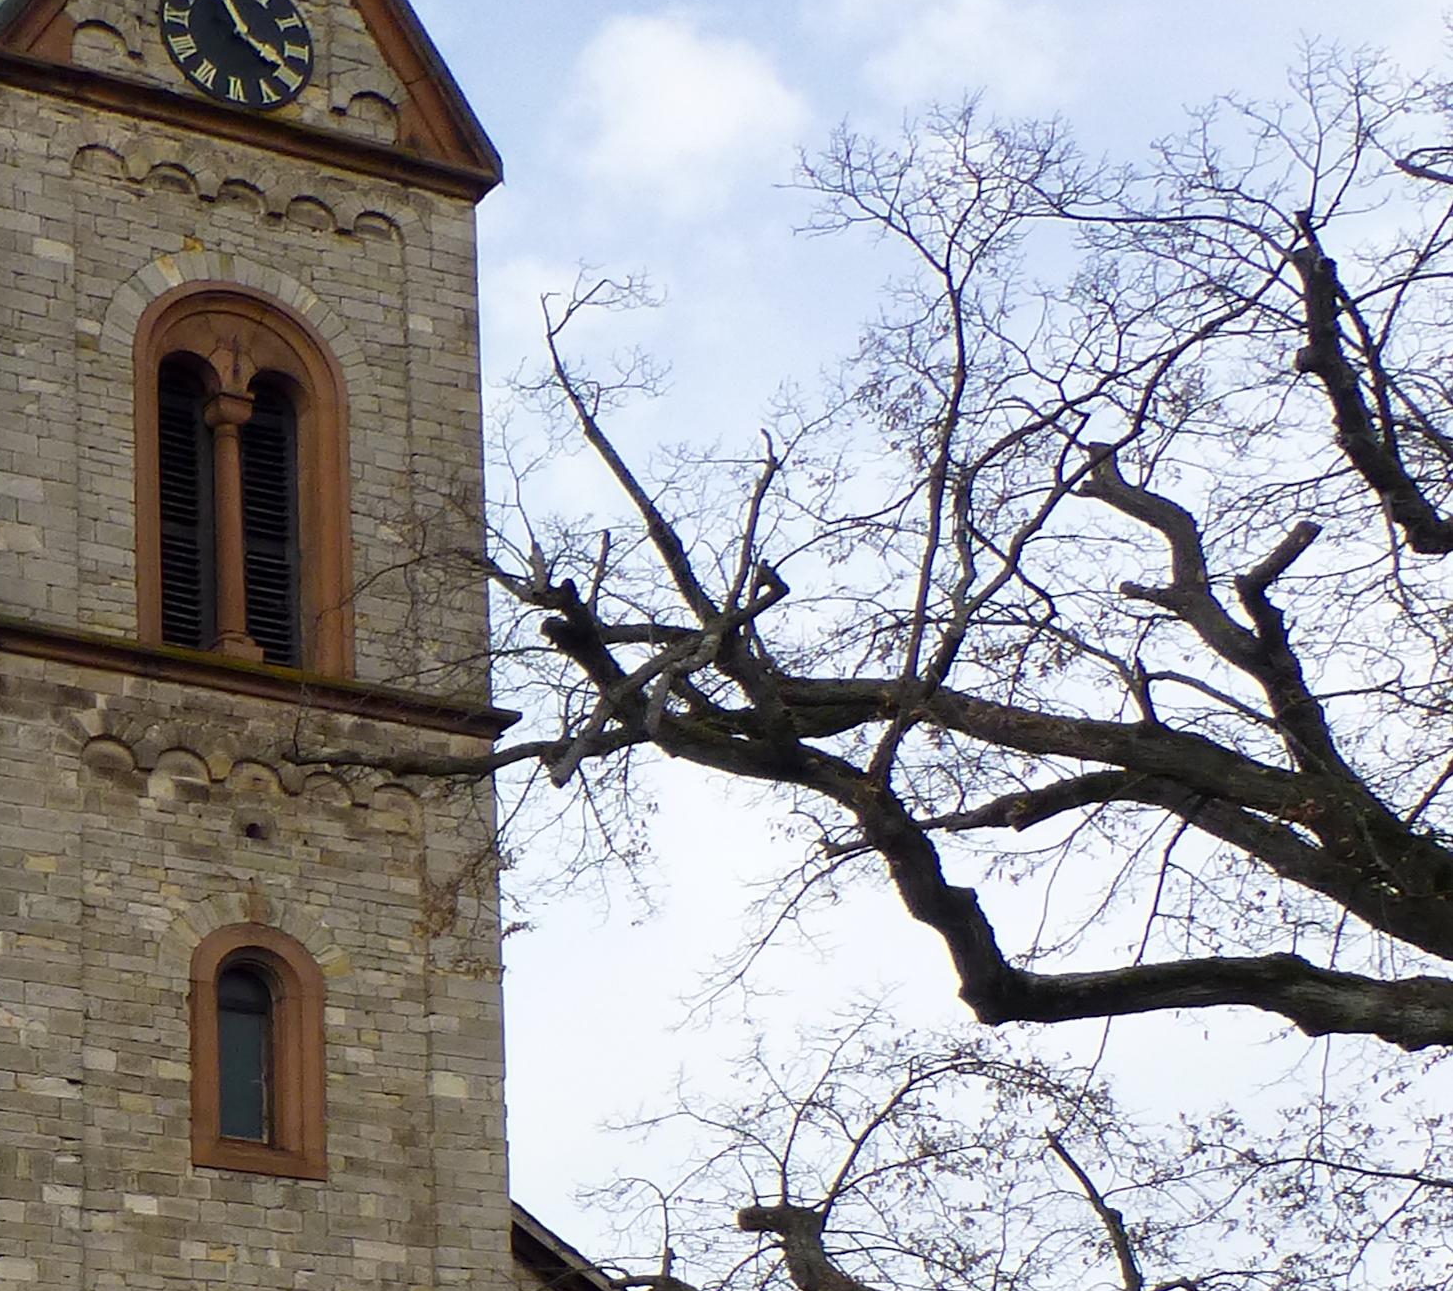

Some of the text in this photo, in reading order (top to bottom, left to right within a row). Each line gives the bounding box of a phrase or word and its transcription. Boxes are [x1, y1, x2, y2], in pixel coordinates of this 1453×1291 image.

[275, 12, 303, 32] II
[167, 34, 198, 64] VIII
[190, 58, 218, 90] VII
[226, 75, 249, 103] VI
[259, 78, 282, 104] V
